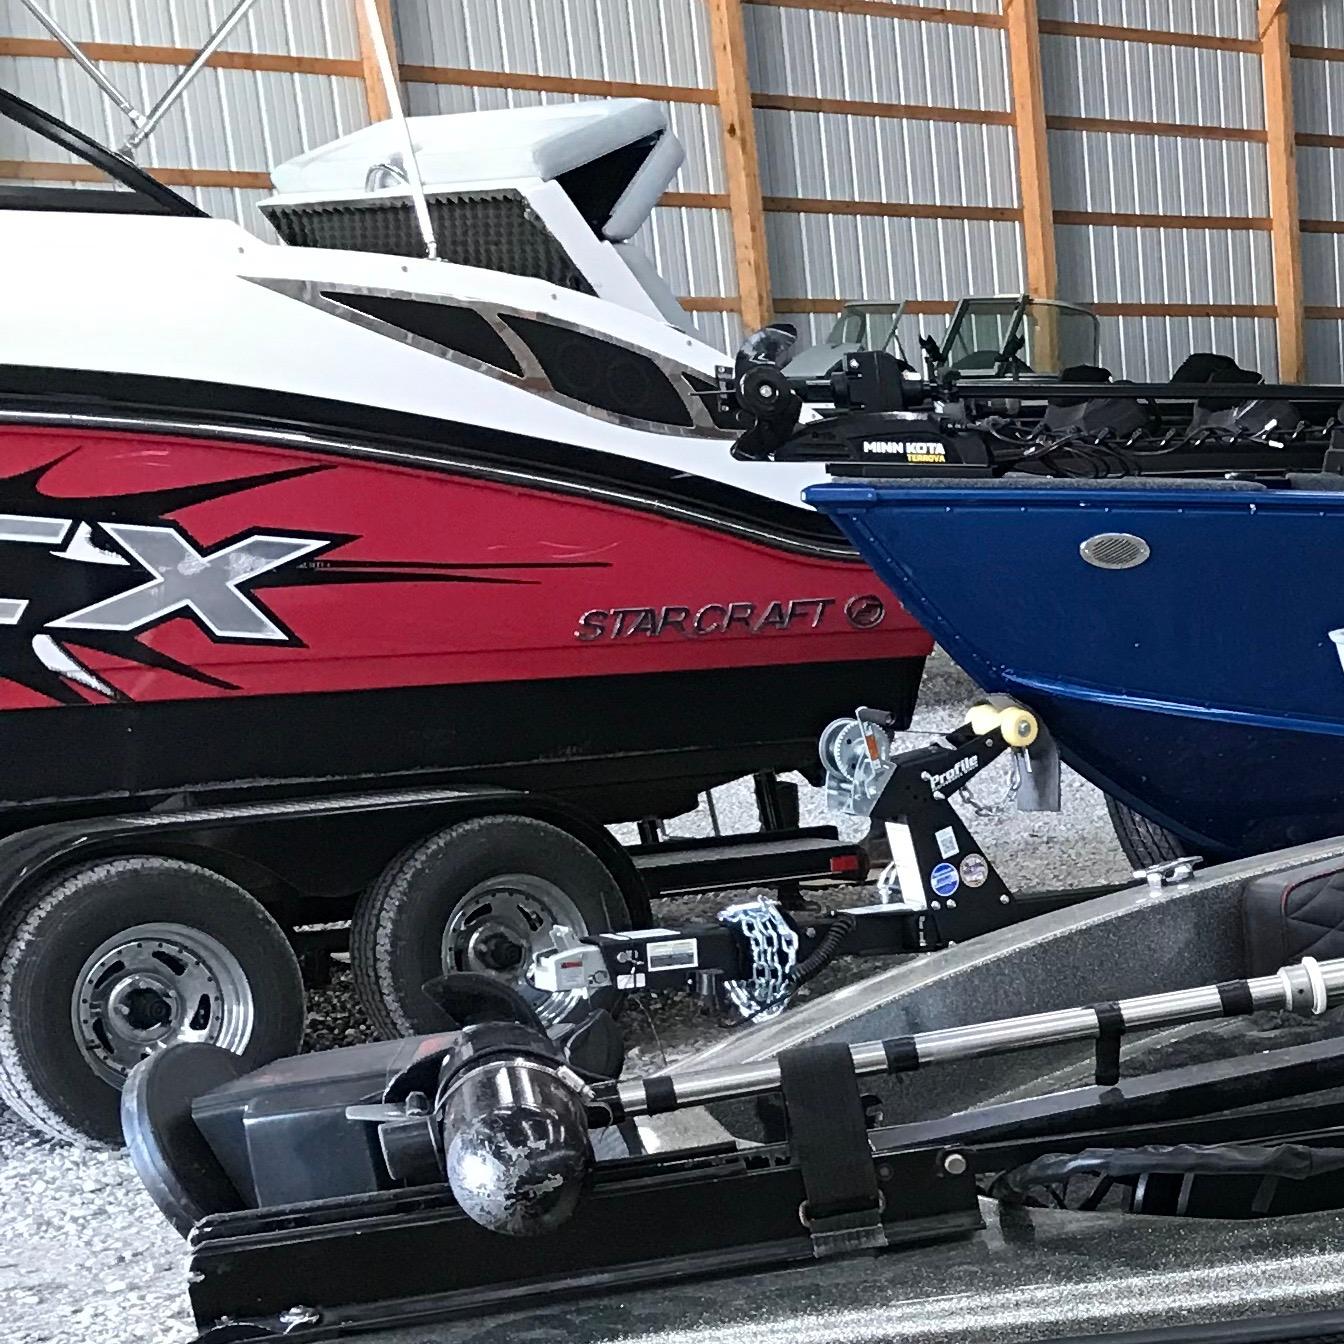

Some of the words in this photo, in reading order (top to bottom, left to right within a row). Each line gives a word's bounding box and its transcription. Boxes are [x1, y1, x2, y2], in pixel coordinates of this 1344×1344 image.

[863, 441, 903, 454] MINN
[906, 442, 945, 454] KOTA
[574, 597, 835, 641] STARCRAFT
[930, 755, 978, 790] Profile
